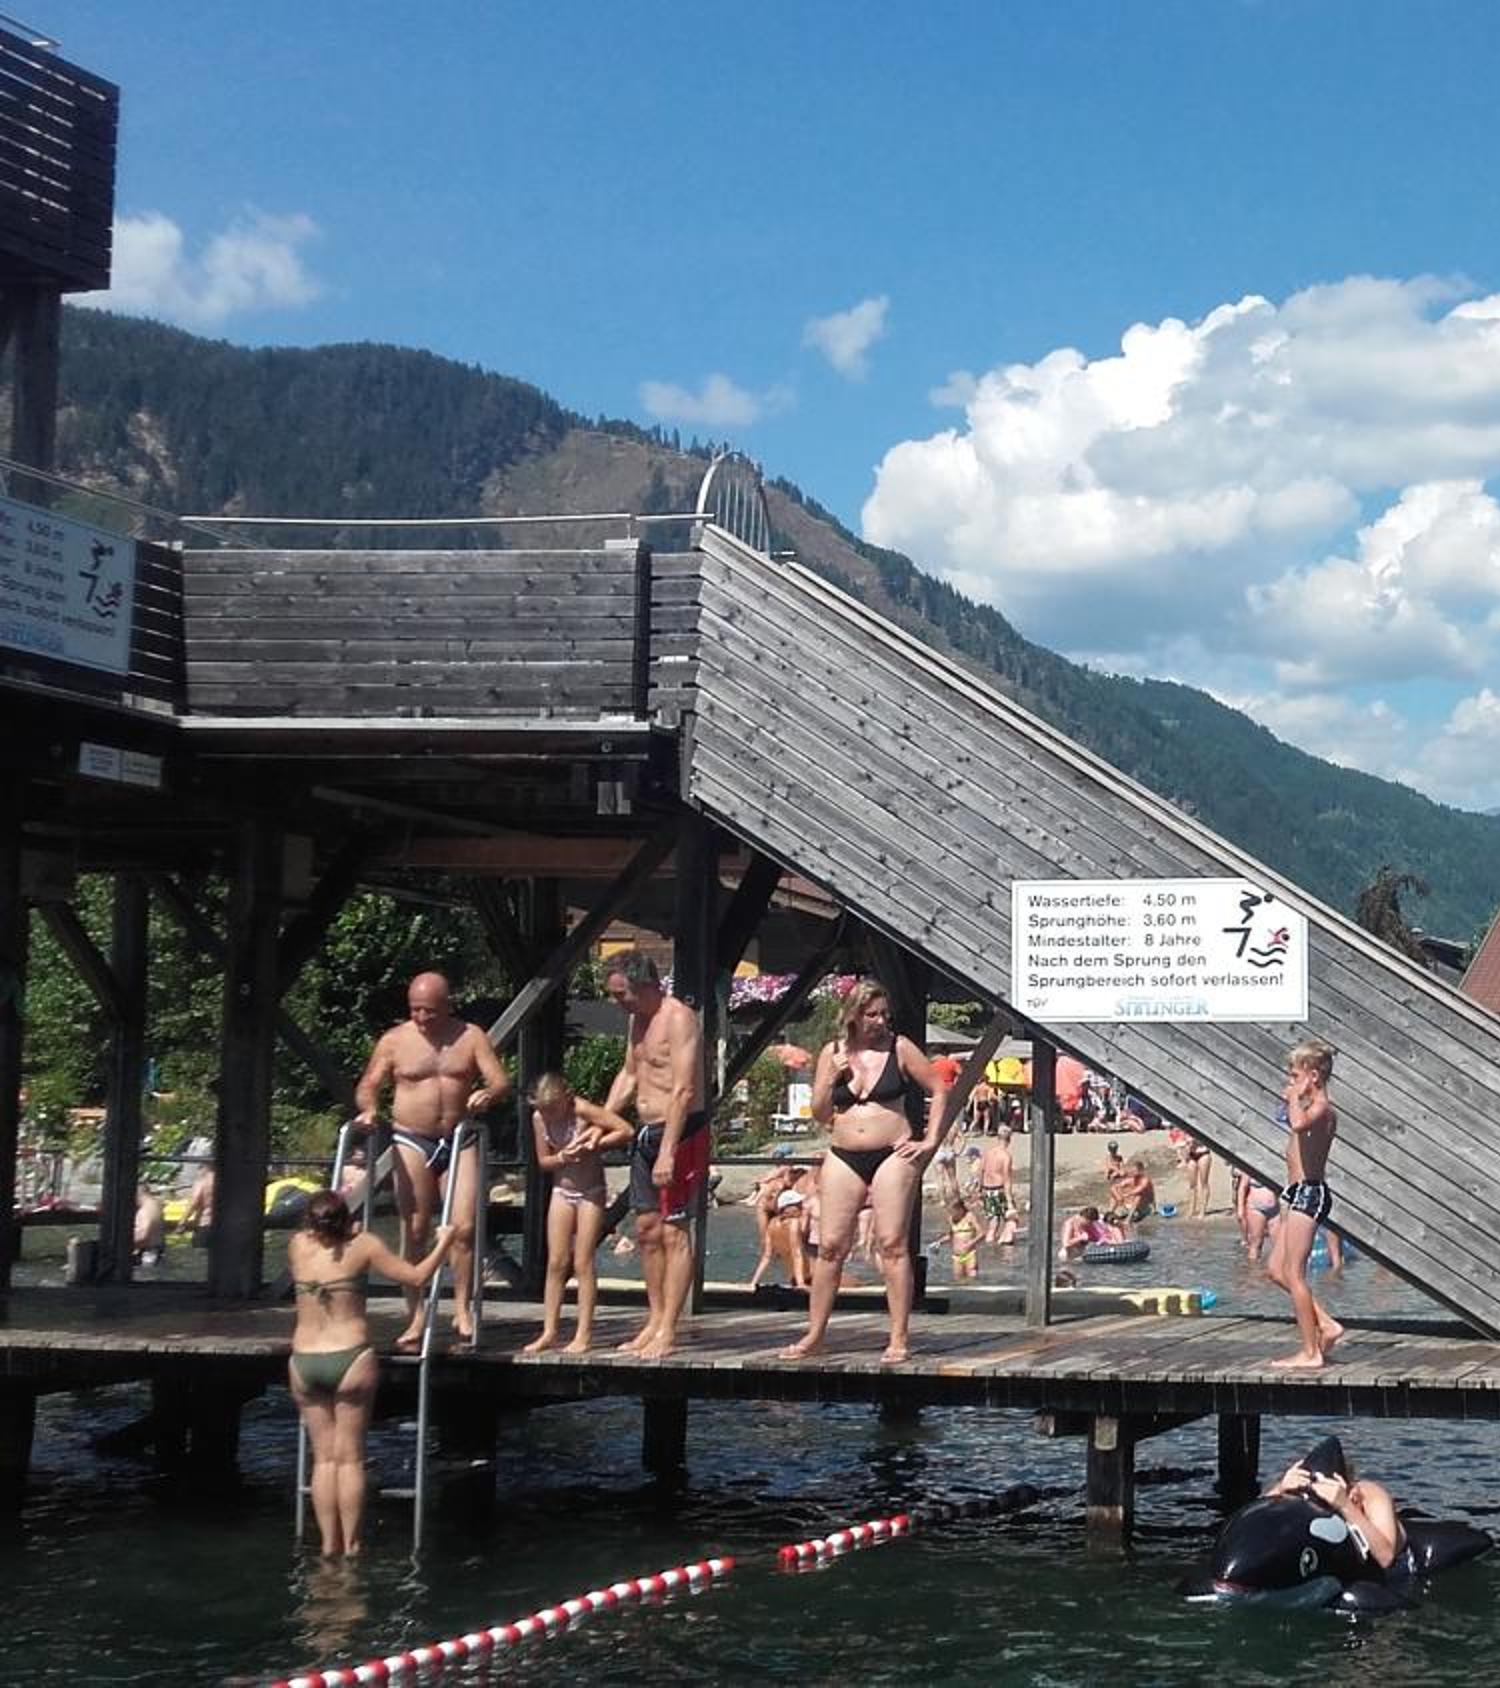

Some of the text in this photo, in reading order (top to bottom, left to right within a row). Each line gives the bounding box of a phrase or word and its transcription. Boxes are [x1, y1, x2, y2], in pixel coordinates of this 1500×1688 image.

[1027, 893, 1197, 908] Wassertiefe: 4.50 m
[1027, 913, 1197, 930] Sprunghöhe: 3.60 m
[1027, 933, 1201, 948] Mindestalter: 8 Jahre
[1027, 953, 1207, 969] Nach dem Sprung den
[1027, 972, 1284, 990] Sprungbereich sofort verlassen!
